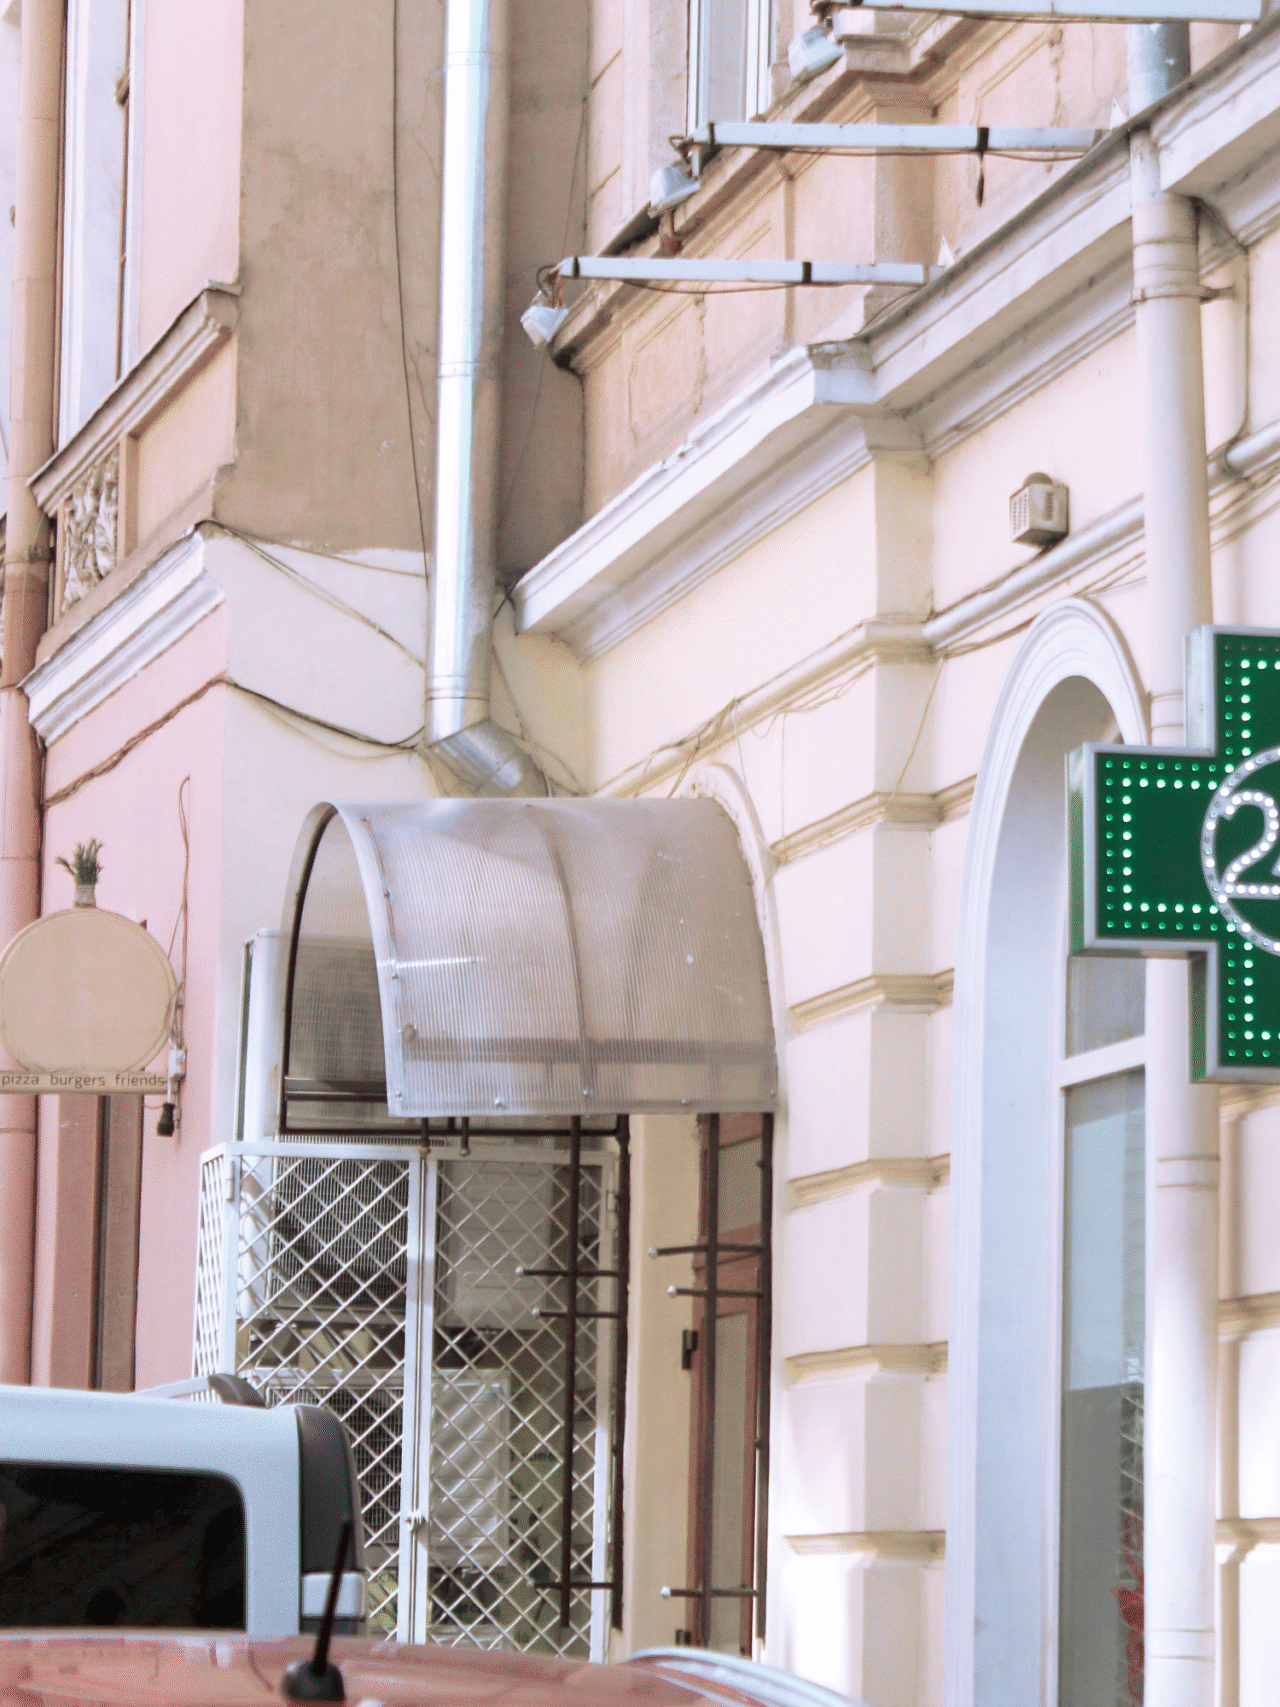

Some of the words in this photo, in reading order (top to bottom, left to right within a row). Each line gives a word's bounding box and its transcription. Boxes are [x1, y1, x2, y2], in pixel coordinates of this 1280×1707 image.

[1, 1074, 39, 1087] pizza
[50, 1073, 106, 1089] burgers
[115, 1073, 166, 1087] friends
